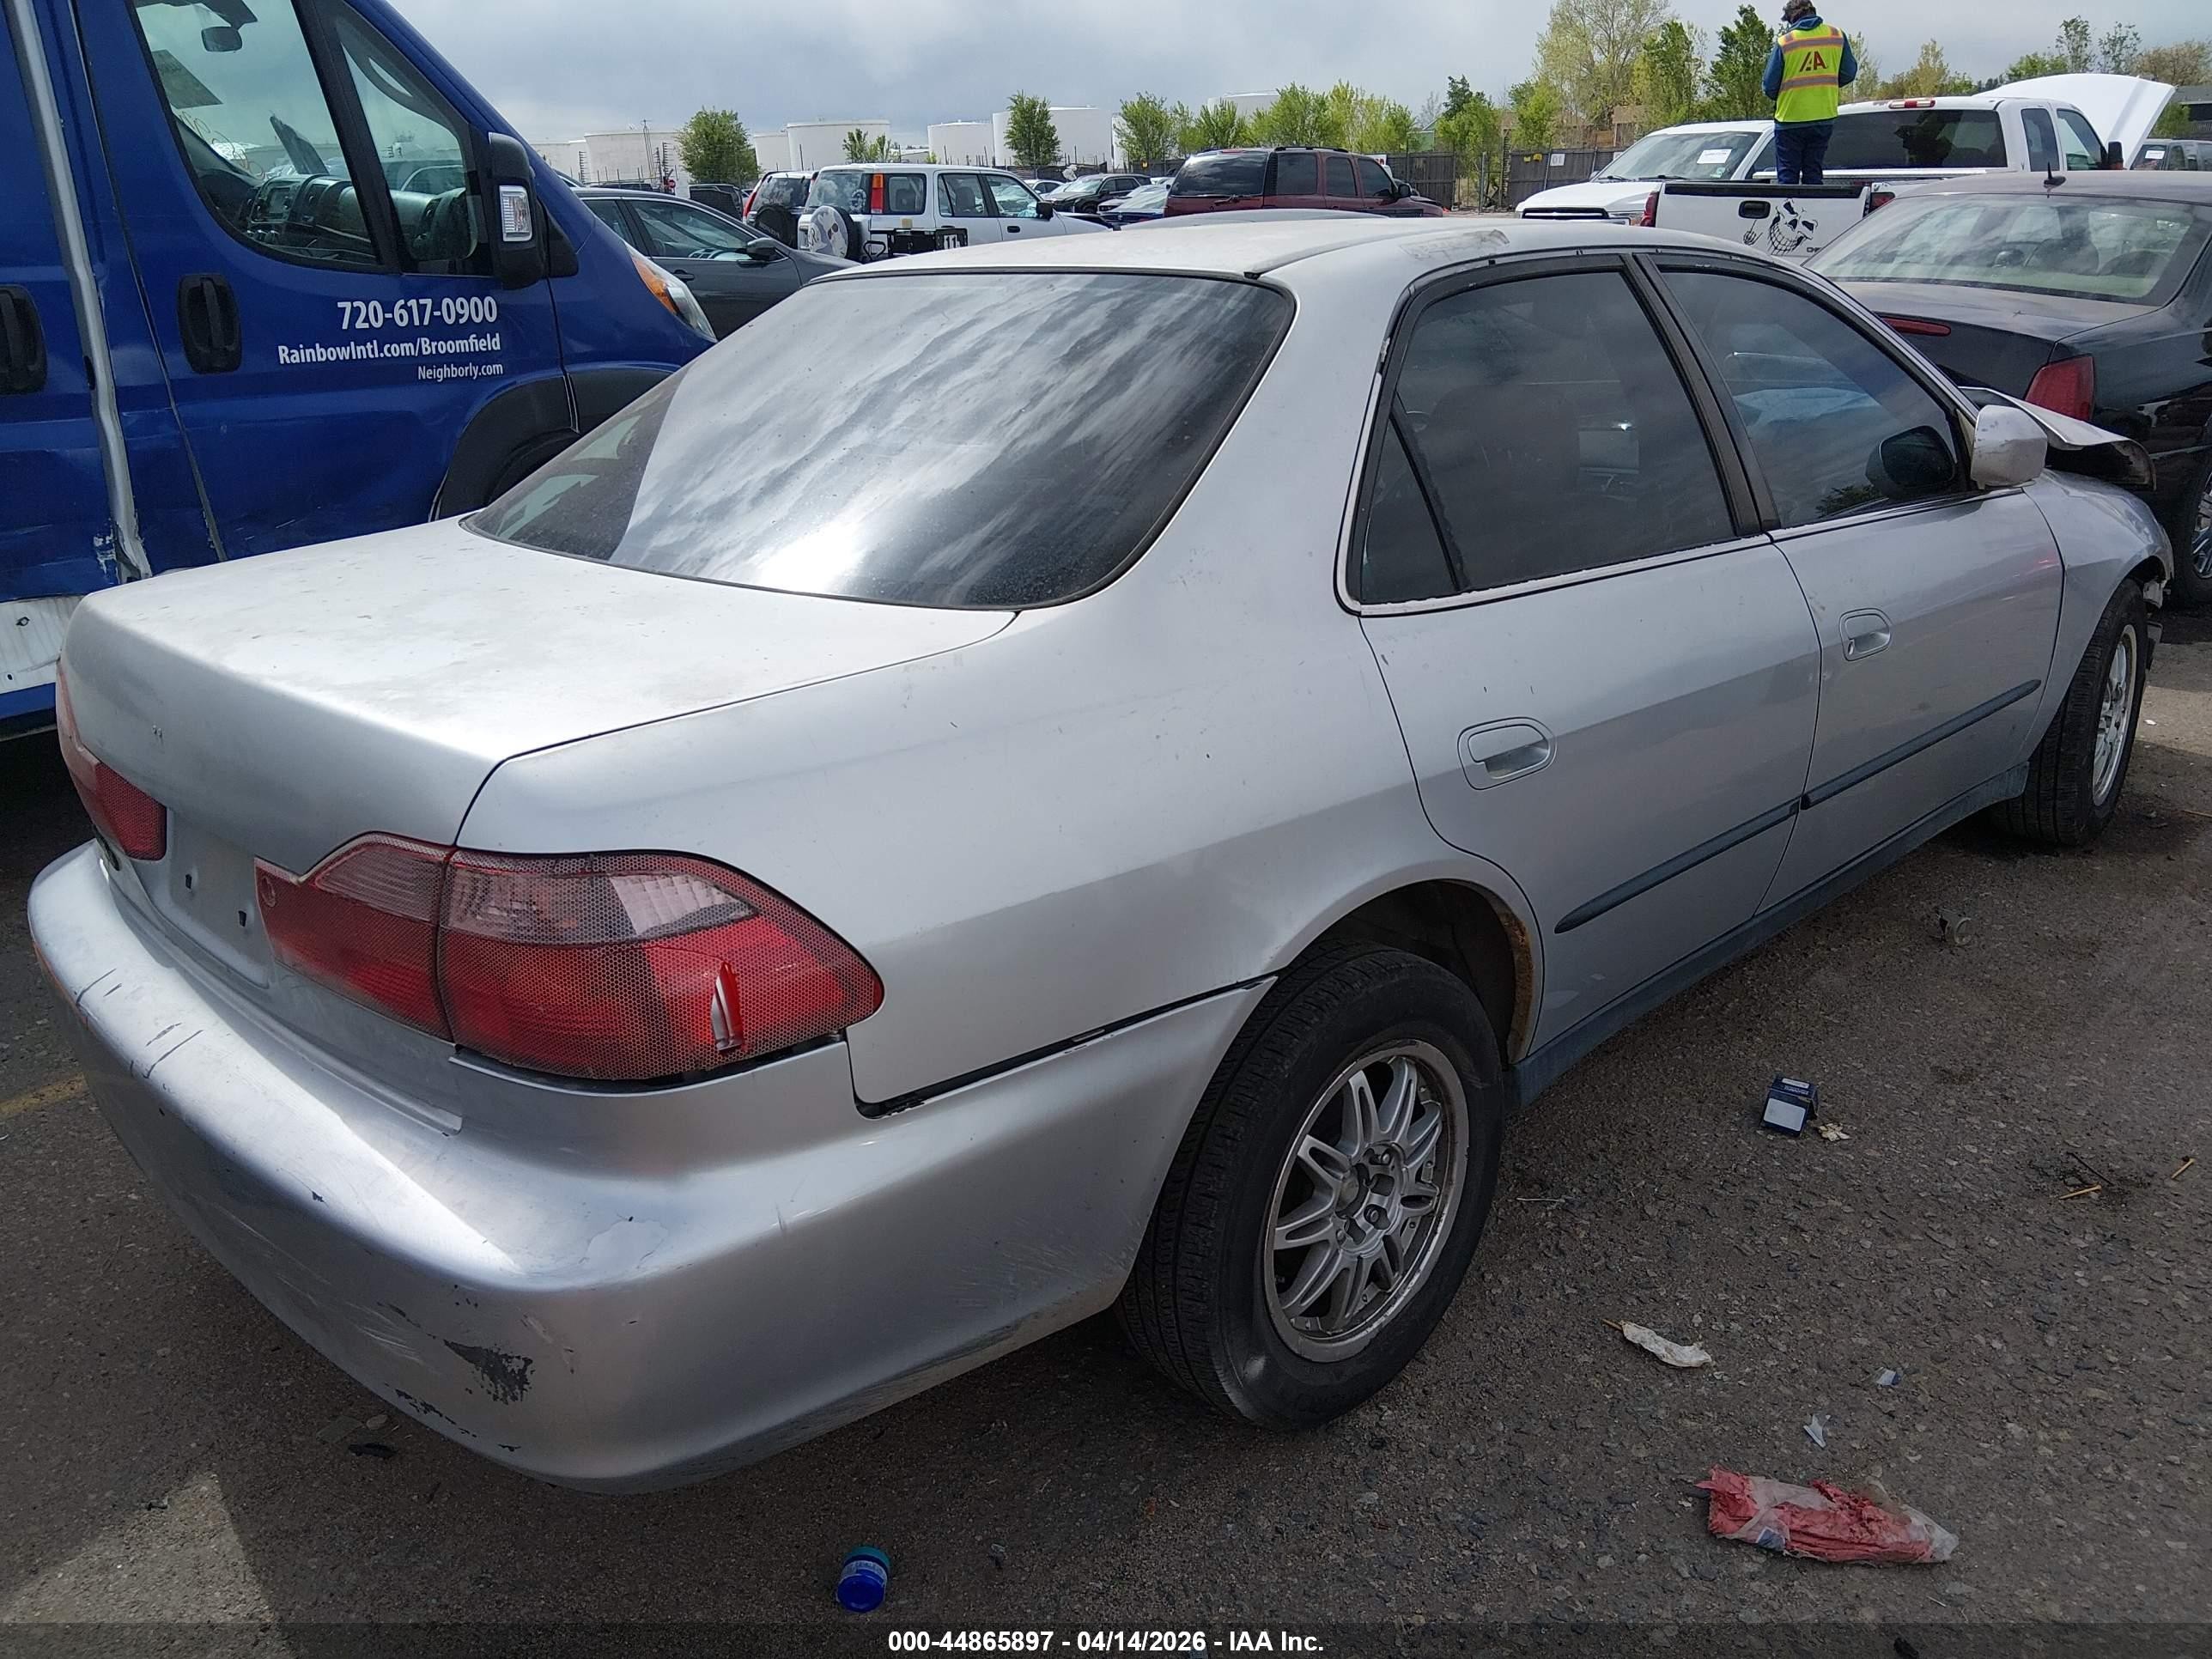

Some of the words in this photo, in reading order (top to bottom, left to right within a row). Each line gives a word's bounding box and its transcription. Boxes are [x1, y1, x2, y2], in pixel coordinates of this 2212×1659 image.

[337, 295, 497, 330] 720-617-0900
[277, 332, 501, 365] RainbowIntl.com/Broomfield
[417, 362, 503, 382] Neighborly.com
